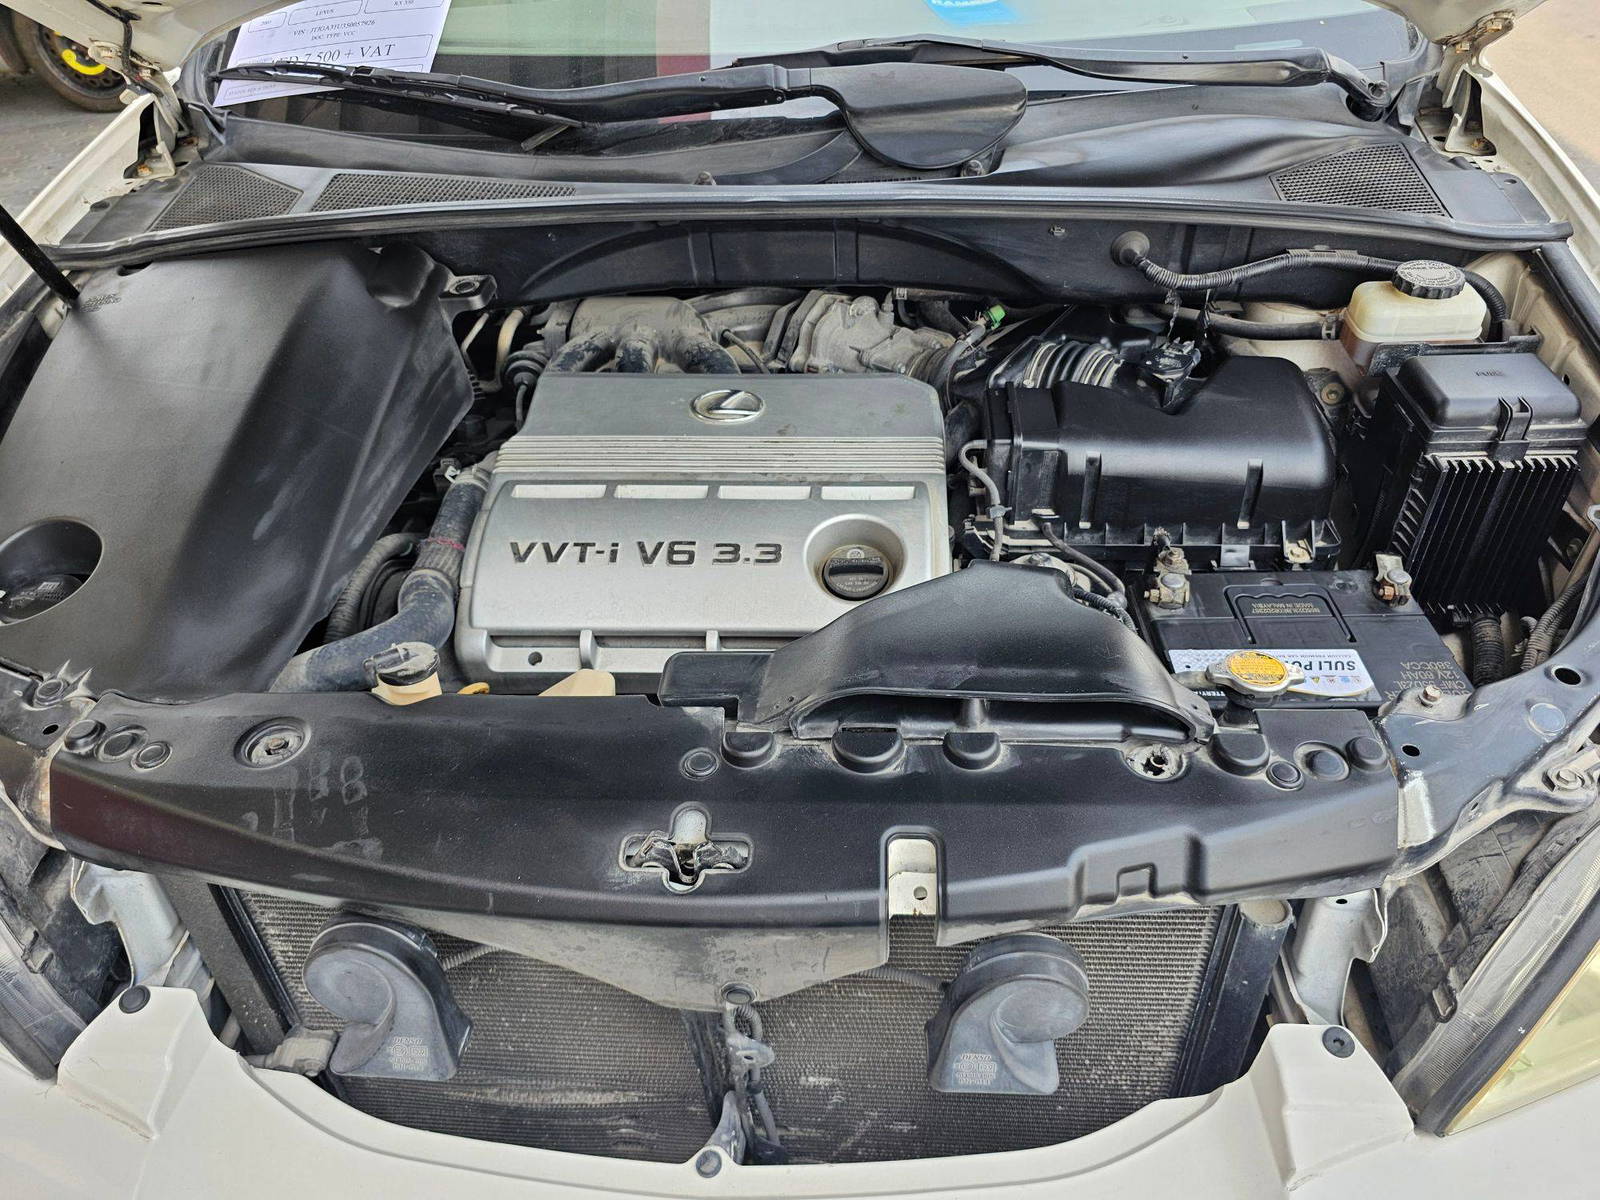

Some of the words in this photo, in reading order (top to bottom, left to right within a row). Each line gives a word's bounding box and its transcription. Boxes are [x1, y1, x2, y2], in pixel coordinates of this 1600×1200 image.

[360, 44, 396, 58] VAT
[509, 541, 619, 564] VVT-i
[636, 541, 696, 566] V6
[712, 542, 783, 565] 3.3
[1318, 659, 1356, 671] SULI
[1437, 670, 1461, 680] 12V
[1439, 680, 1466, 690] CMF
